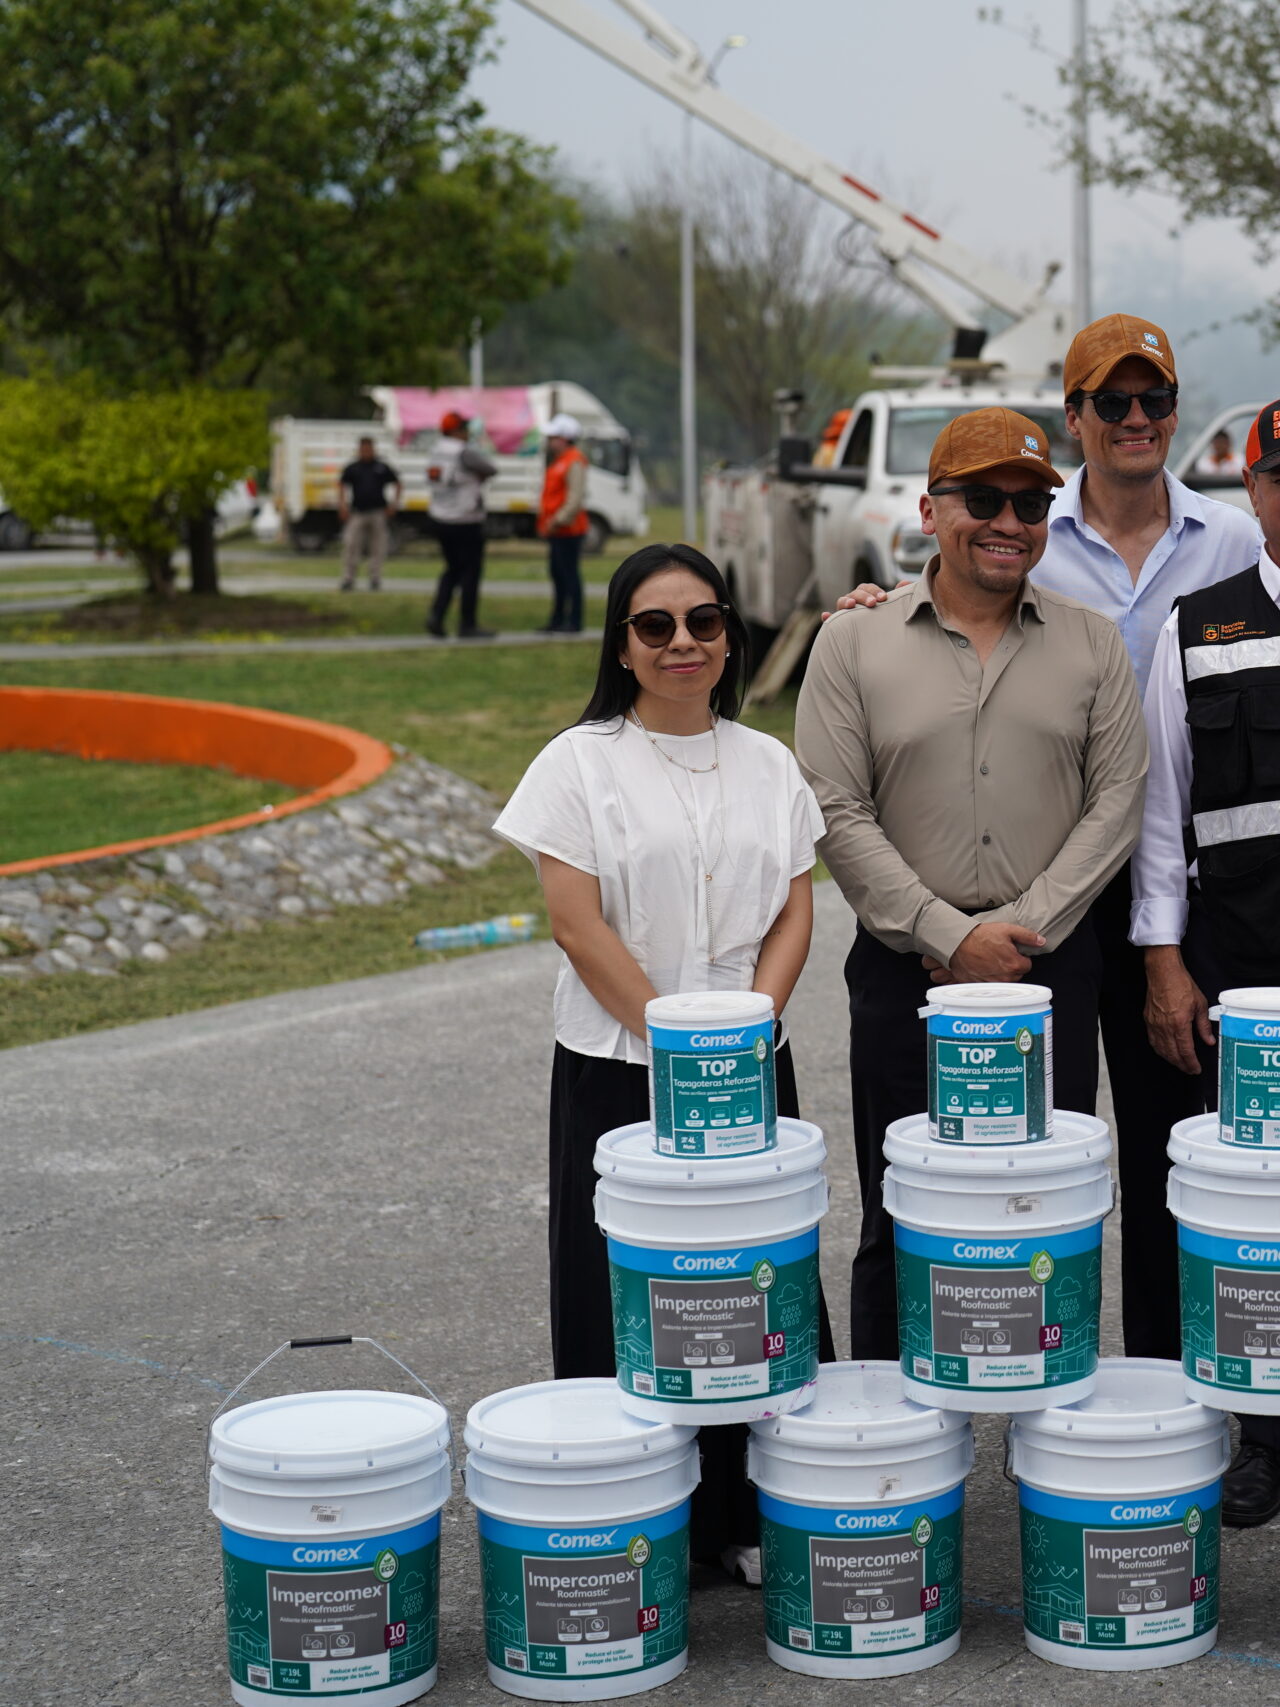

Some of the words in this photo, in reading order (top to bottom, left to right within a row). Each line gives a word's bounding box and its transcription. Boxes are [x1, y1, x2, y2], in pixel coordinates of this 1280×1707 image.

[1142, 344, 1164, 359] Comex
[1021, 449, 1043, 460] Comex
[952, 1020, 1007, 1034] Comex
[690, 1030, 746, 1047] Comex
[958, 1047, 996, 1064] TOP
[697, 1059, 737, 1077] TOP
[939, 1064, 981, 1075] Tapagoteras
[983, 1066, 1023, 1074] Reforzado
[674, 1078, 722, 1089] Tapagoteras
[724, 1075, 761, 1086] Reforzado
[953, 1242, 1022, 1259] Comex
[673, 1251, 743, 1271] Comex
[758, 1275, 771, 1283] ECO
[935, 1280, 1038, 1300] Impercomex
[655, 1295, 760, 1313] Impercomex
[961, 1301, 1011, 1309] Roofmastic
[683, 1313, 733, 1322] Roofmastic
[1044, 1327, 1060, 1341] 10
[768, 1334, 783, 1350] 10
[1045, 1340, 1058, 1348] años
[769, 1348, 783, 1356] años
[1232, 1364, 1243, 1372] 19L
[671, 1375, 684, 1384] 19L
[1226, 1372, 1241, 1380] Mate
[1111, 1500, 1176, 1520] Comex
[835, 1510, 903, 1529] Comex
[548, 1528, 619, 1548] Comex
[917, 1530, 929, 1538] ECO
[293, 1543, 365, 1562] Comex
[634, 1550, 647, 1558] ECO
[1090, 1542, 1189, 1563] Impercomex
[815, 1552, 917, 1571] Impercomex
[1119, 1559, 1166, 1569] Roofmastic
[844, 1568, 893, 1578] Roofmastic
[529, 1572, 635, 1591] Impercomex
[1195, 1578, 1205, 1593] 10
[273, 1585, 382, 1606] Impercomex
[558, 1589, 608, 1598] Roofmastic
[925, 1588, 938, 1603] 10
[302, 1605, 353, 1614] Roofmastic
[926, 1600, 937, 1609] años
[643, 1608, 657, 1624] 10
[389, 1624, 405, 1640] 10
[644, 1621, 656, 1630] años
[1104, 1623, 1117, 1631] 19L
[831, 1631, 843, 1639] 19L
[545, 1652, 558, 1660] 19L
[289, 1668, 302, 1677] 19L
